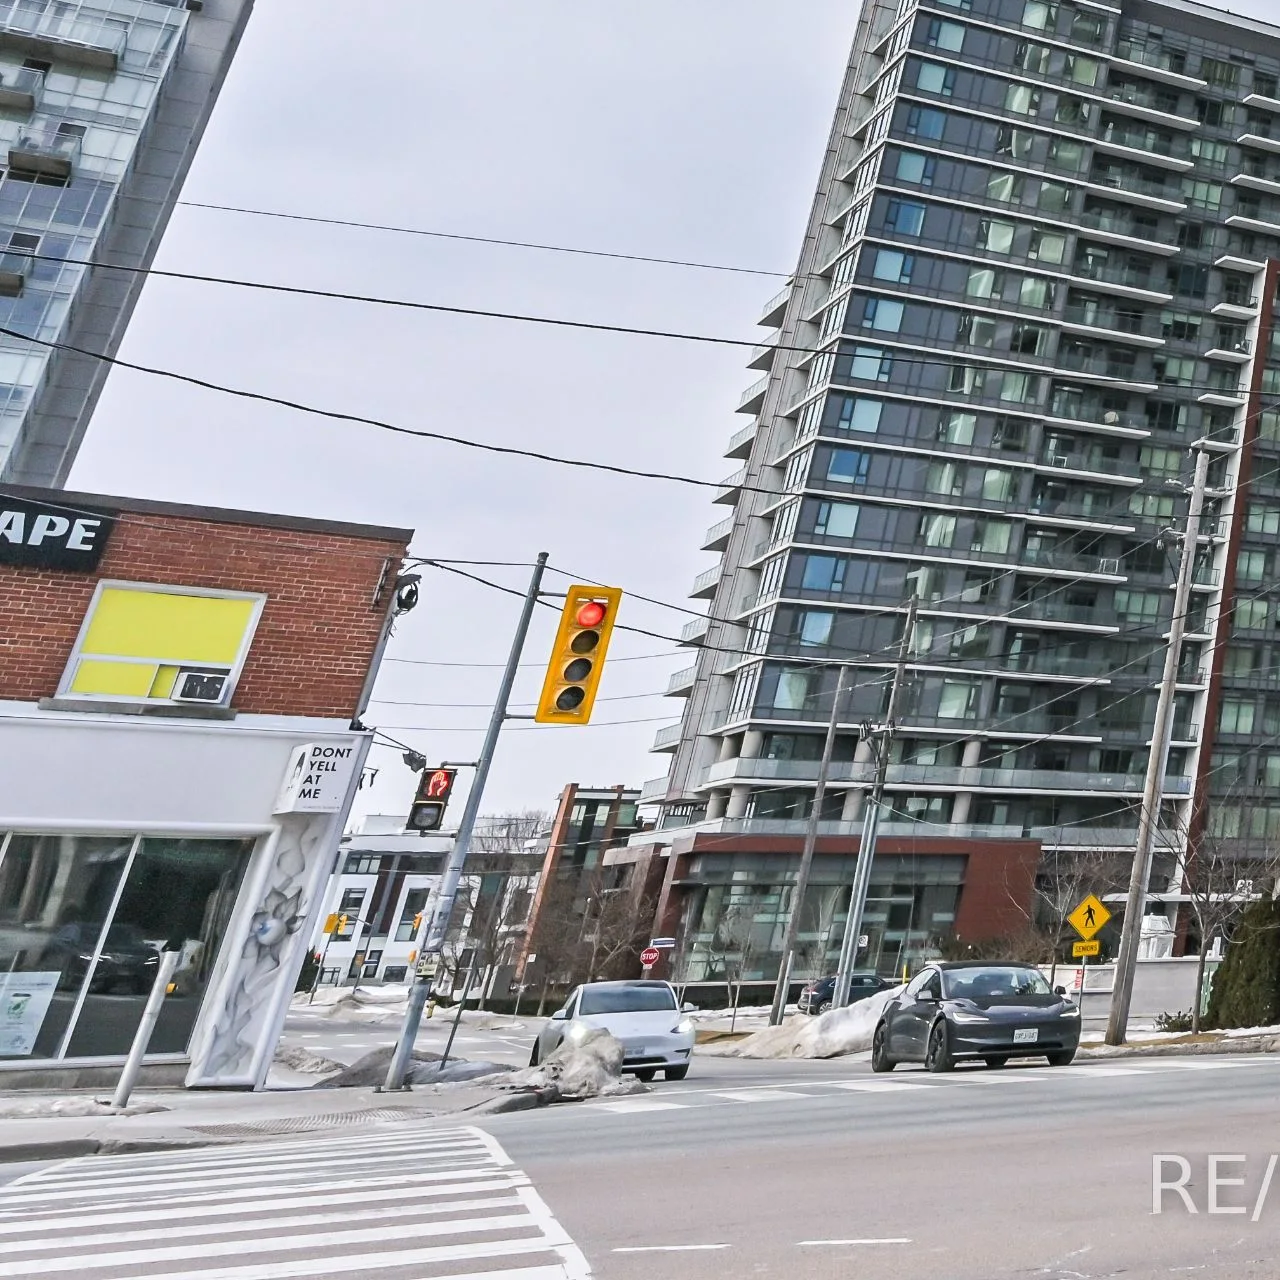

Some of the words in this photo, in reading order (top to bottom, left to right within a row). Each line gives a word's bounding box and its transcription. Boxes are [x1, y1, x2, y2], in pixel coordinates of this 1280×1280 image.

[312, 746, 353, 758] DONT
[309, 760, 337, 772] YELL
[303, 774, 322, 785] AT
[298, 788, 321, 799] ME
[642, 952, 658, 961] STOP
